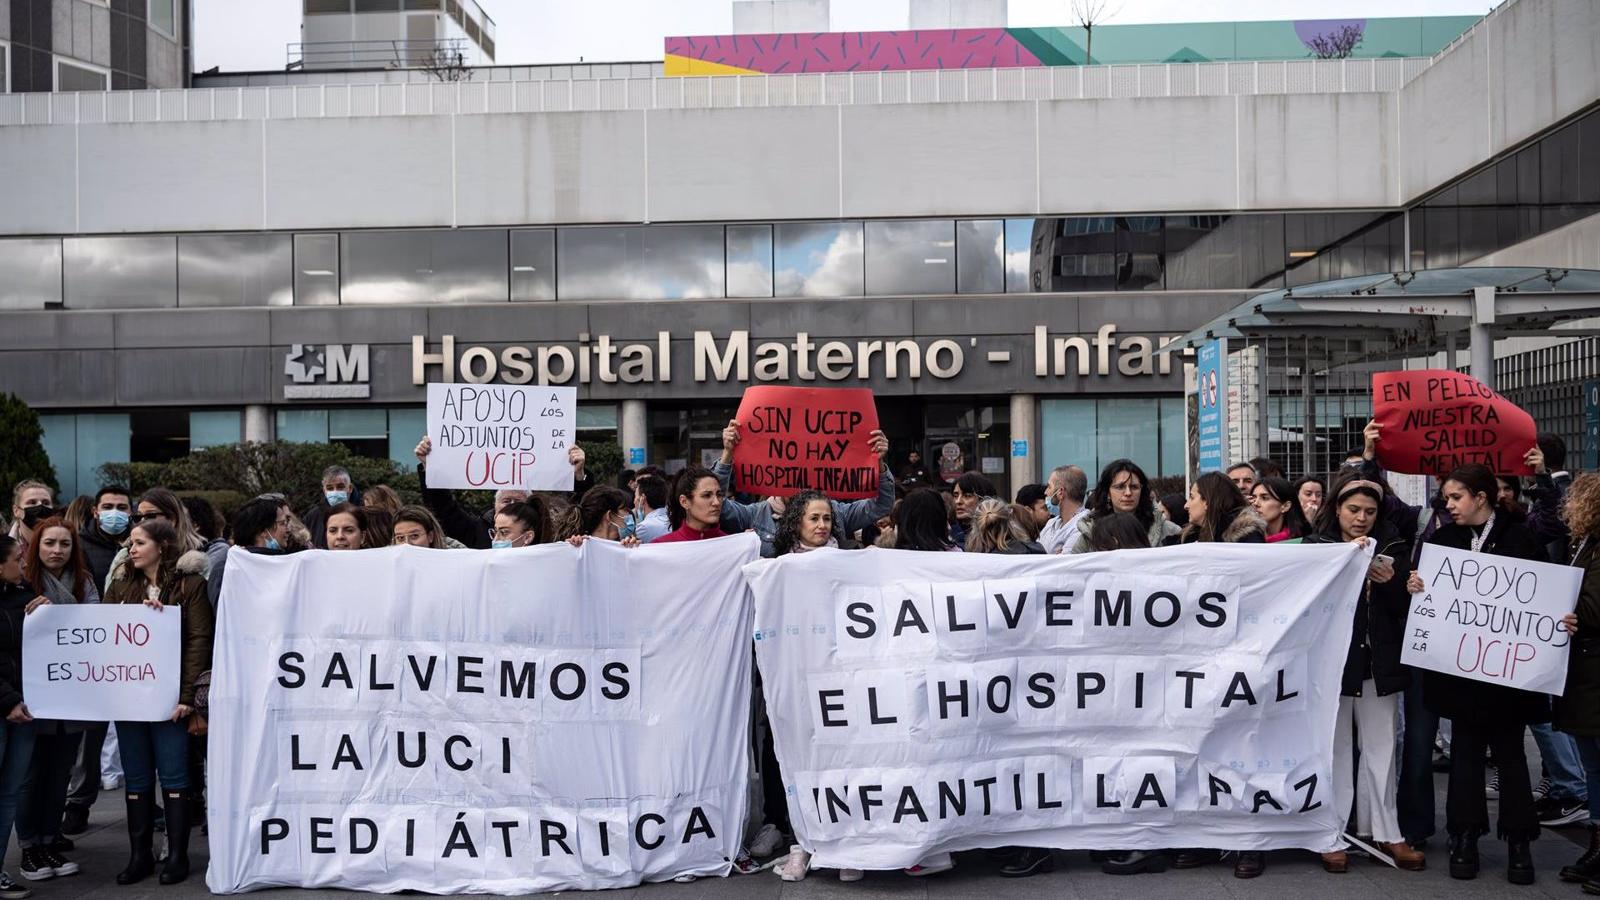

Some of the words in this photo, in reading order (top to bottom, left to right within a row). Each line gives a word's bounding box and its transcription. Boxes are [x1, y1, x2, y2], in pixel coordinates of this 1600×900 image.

[412, 331, 671, 387] Hospital
[694, 330, 964, 381] Materno
[550, 393, 559, 403] A
[1383, 381, 1410, 401] EN
[442, 387, 526, 422] APOYO
[541, 408, 564, 417] LOS
[748, 406, 791, 433] SIN
[805, 409, 862, 434] UCIP
[1403, 404, 1499, 431] NUESTRA
[440, 425, 535, 450] ADJUNTOS
[552, 429, 566, 437] DE
[552, 440, 565, 449] LA
[1419, 429, 1497, 451] SALUD
[768, 438, 798, 460] NO
[806, 439, 850, 461] HAY
[741, 464, 813, 489] HOSPITAL
[814, 467, 878, 492] INFANTIL
[1431, 556, 1538, 604] APOYO
[1423, 593, 1433, 603] A
[846, 590, 1228, 640] SALVEMOS
[1413, 605, 1436, 618] LOS
[1445, 598, 1570, 648] ADJUNTOS
[56, 627, 107, 646] ESTO
[114, 622, 150, 646] NO
[1413, 628, 1430, 640] DE
[1412, 642, 1428, 653] LA
[47, 662, 73, 682] ES
[77, 661, 156, 683] JUSTICIA
[277, 651, 631, 701] SALVEMOS
[819, 686, 898, 728] EL
[937, 668, 1300, 721] HOSPITAL
[291, 733, 364, 771] LA
[396, 730, 512, 774] UCI
[1096, 772, 1169, 809] LA
[1208, 772, 1323, 814] PAZ
[260, 806, 718, 858] PEDIÁTRICA
